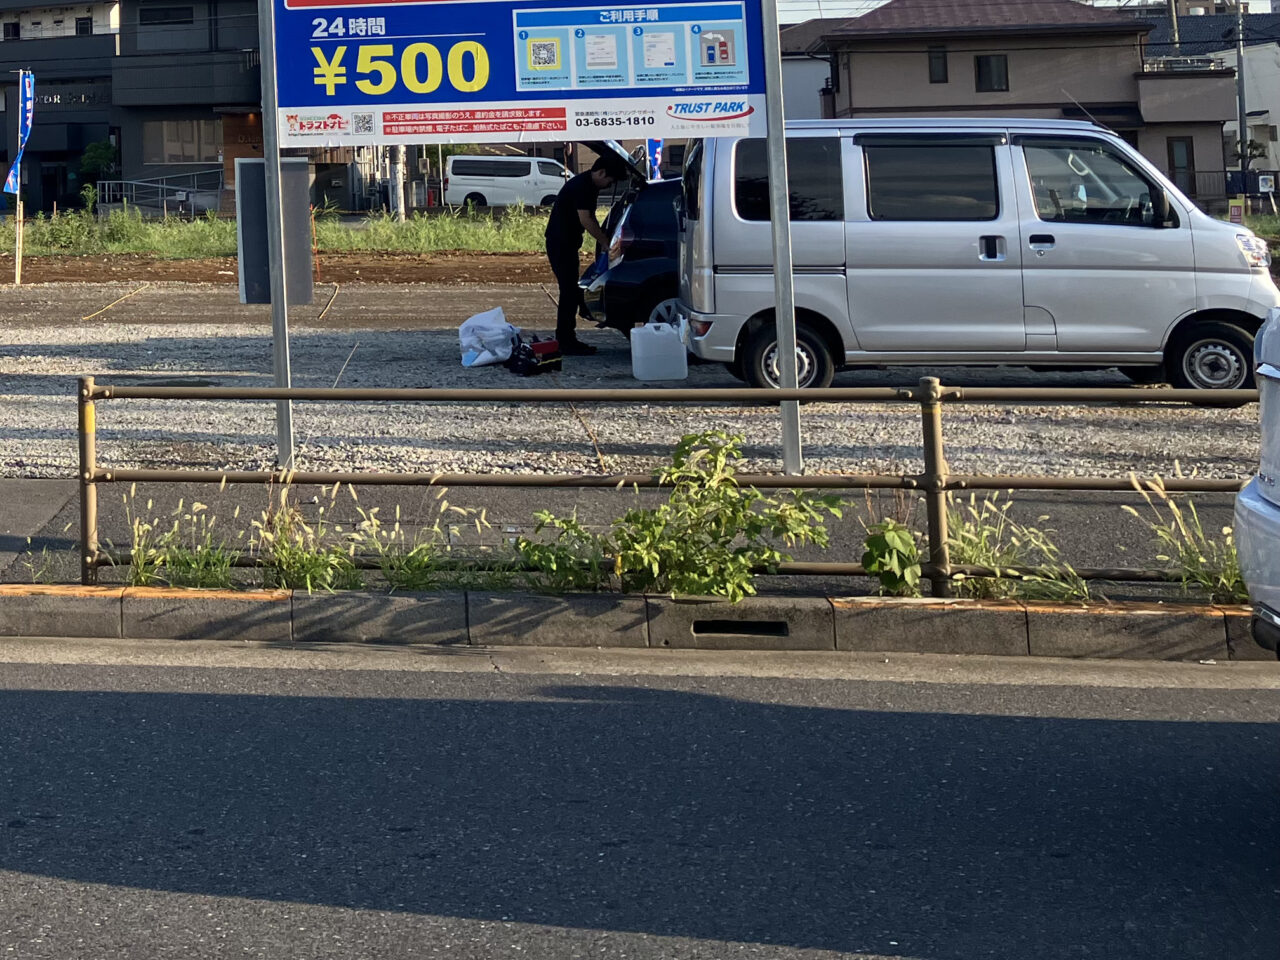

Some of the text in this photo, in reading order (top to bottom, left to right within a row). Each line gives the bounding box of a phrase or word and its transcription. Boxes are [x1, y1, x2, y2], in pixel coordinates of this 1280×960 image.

[599, 9, 659, 22] ご利用手順
[312, 17, 386, 37] 24時間
[310, 40, 490, 96] ¥500
[673, 101, 746, 114] TRUST PARK
[575, 116, 655, 127] 03-6835-1810
